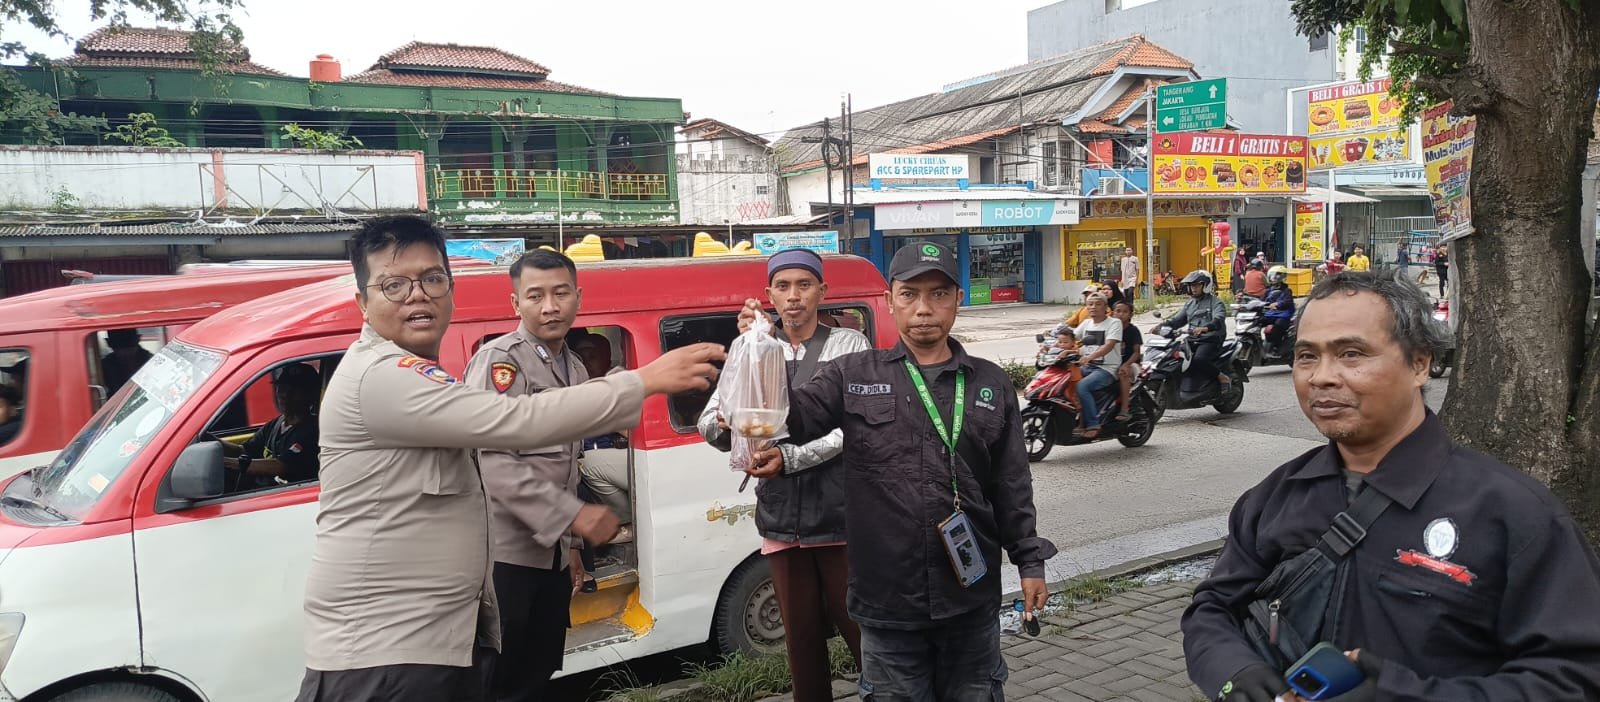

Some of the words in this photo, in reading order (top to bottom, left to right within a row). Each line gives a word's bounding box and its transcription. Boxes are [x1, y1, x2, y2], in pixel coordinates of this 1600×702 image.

[1163, 86, 1194, 96] TANGERANG
[1312, 89, 1332, 101] BELI
[1334, 88, 1339, 99] 1
[1342, 82, 1375, 97] GRATIS
[1377, 81, 1382, 92] 1
[1162, 97, 1184, 105] JAKARTA
[1190, 136, 1223, 153] BELI
[1228, 137, 1235, 153] 1
[1240, 138, 1280, 155] GRATIS
[1282, 140, 1288, 155] 1
[894, 157, 917, 165] LUCKY
[920, 157, 946, 165] CIRUAS
[877, 166, 893, 175] ACC
[894, 166, 900, 174] &
[902, 166, 950, 175] SPAREPART
[952, 166, 963, 175] HP
[994, 207, 1043, 219] ROBOT
